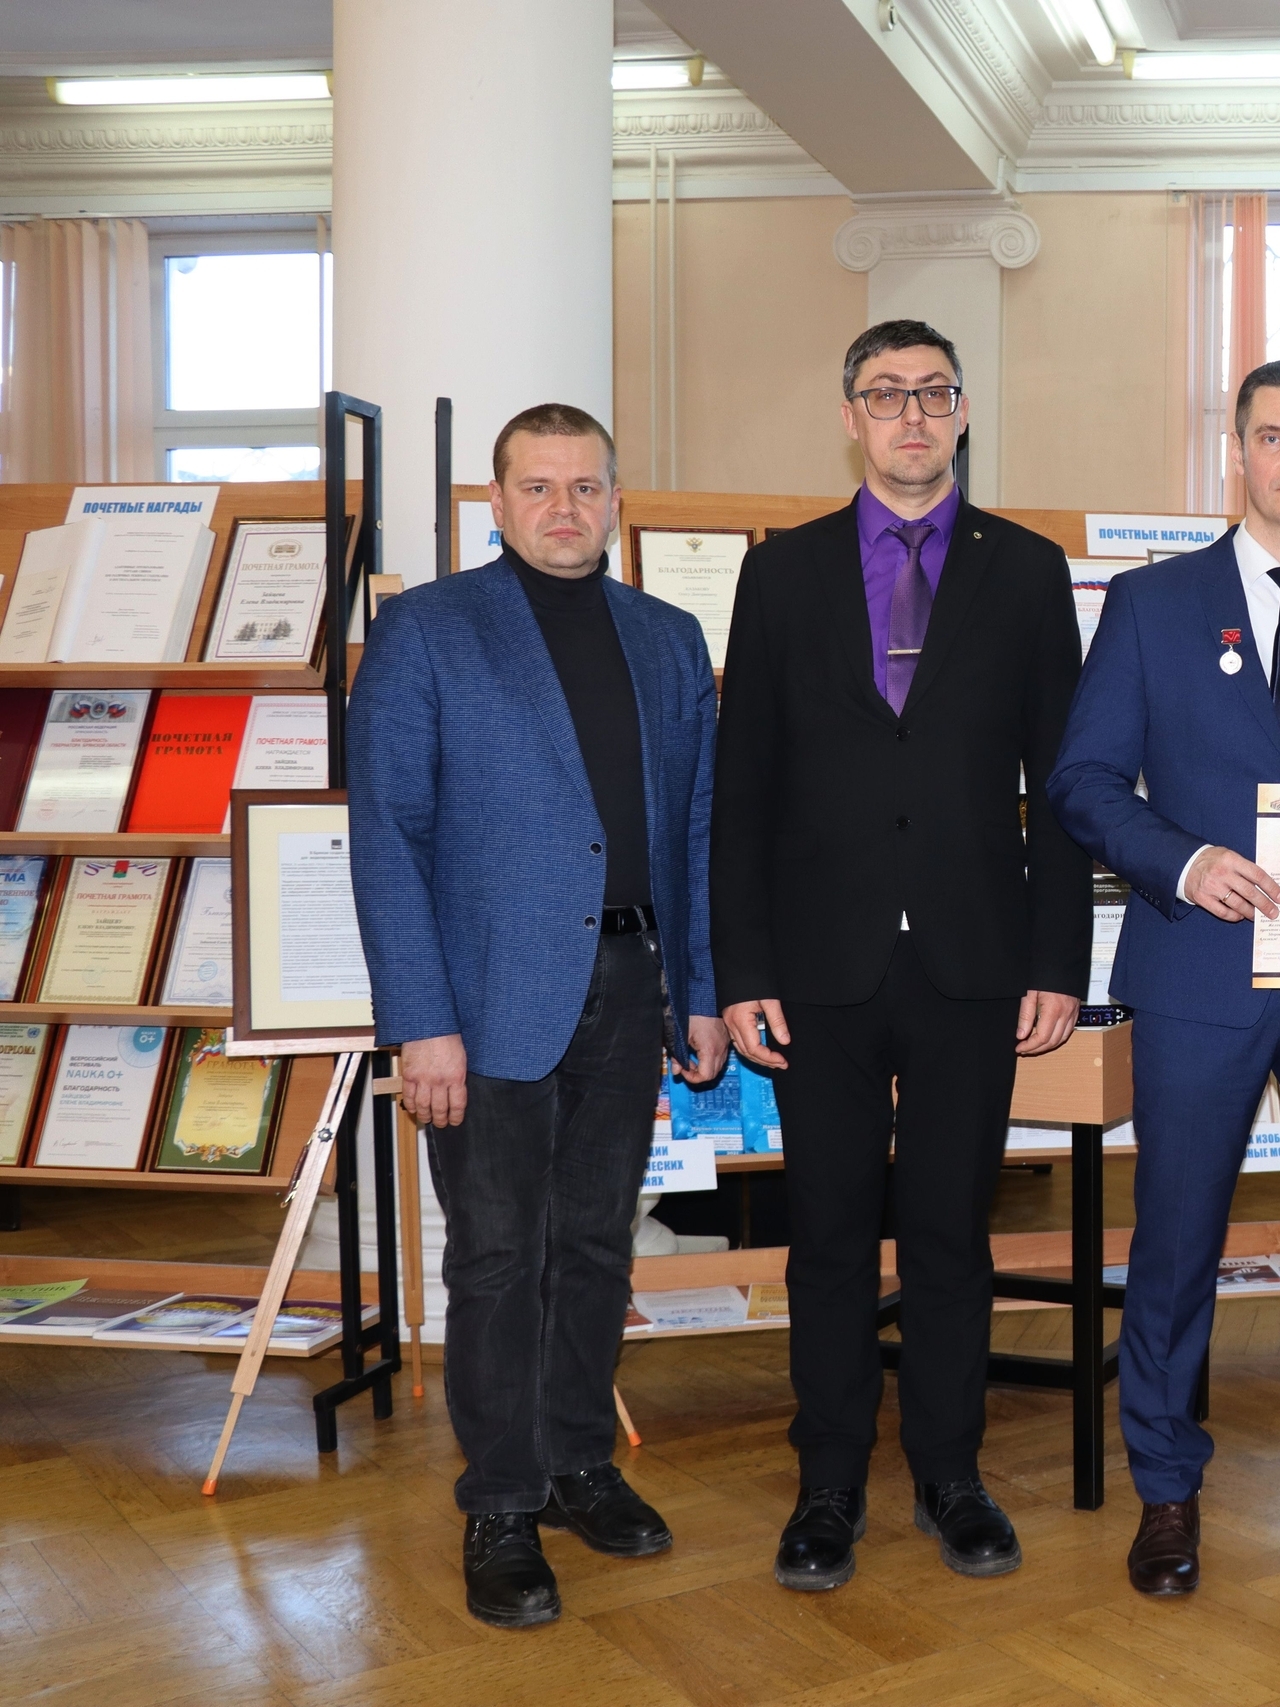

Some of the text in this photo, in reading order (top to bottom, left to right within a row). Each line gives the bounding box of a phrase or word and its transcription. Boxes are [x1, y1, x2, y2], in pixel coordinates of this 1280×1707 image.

[82, 502, 203, 514] ПОЧЕТНЫЕ НАГРАДЫ
[1099, 528, 1215, 543] ПОЧЕТНЫЕ НАГРАДЫ
[151, 733, 233, 742] ПОЧЕТНАЯ
[155, 746, 223, 755] ГРАМОТА
[66, 1070, 104, 1079] NAUKA
